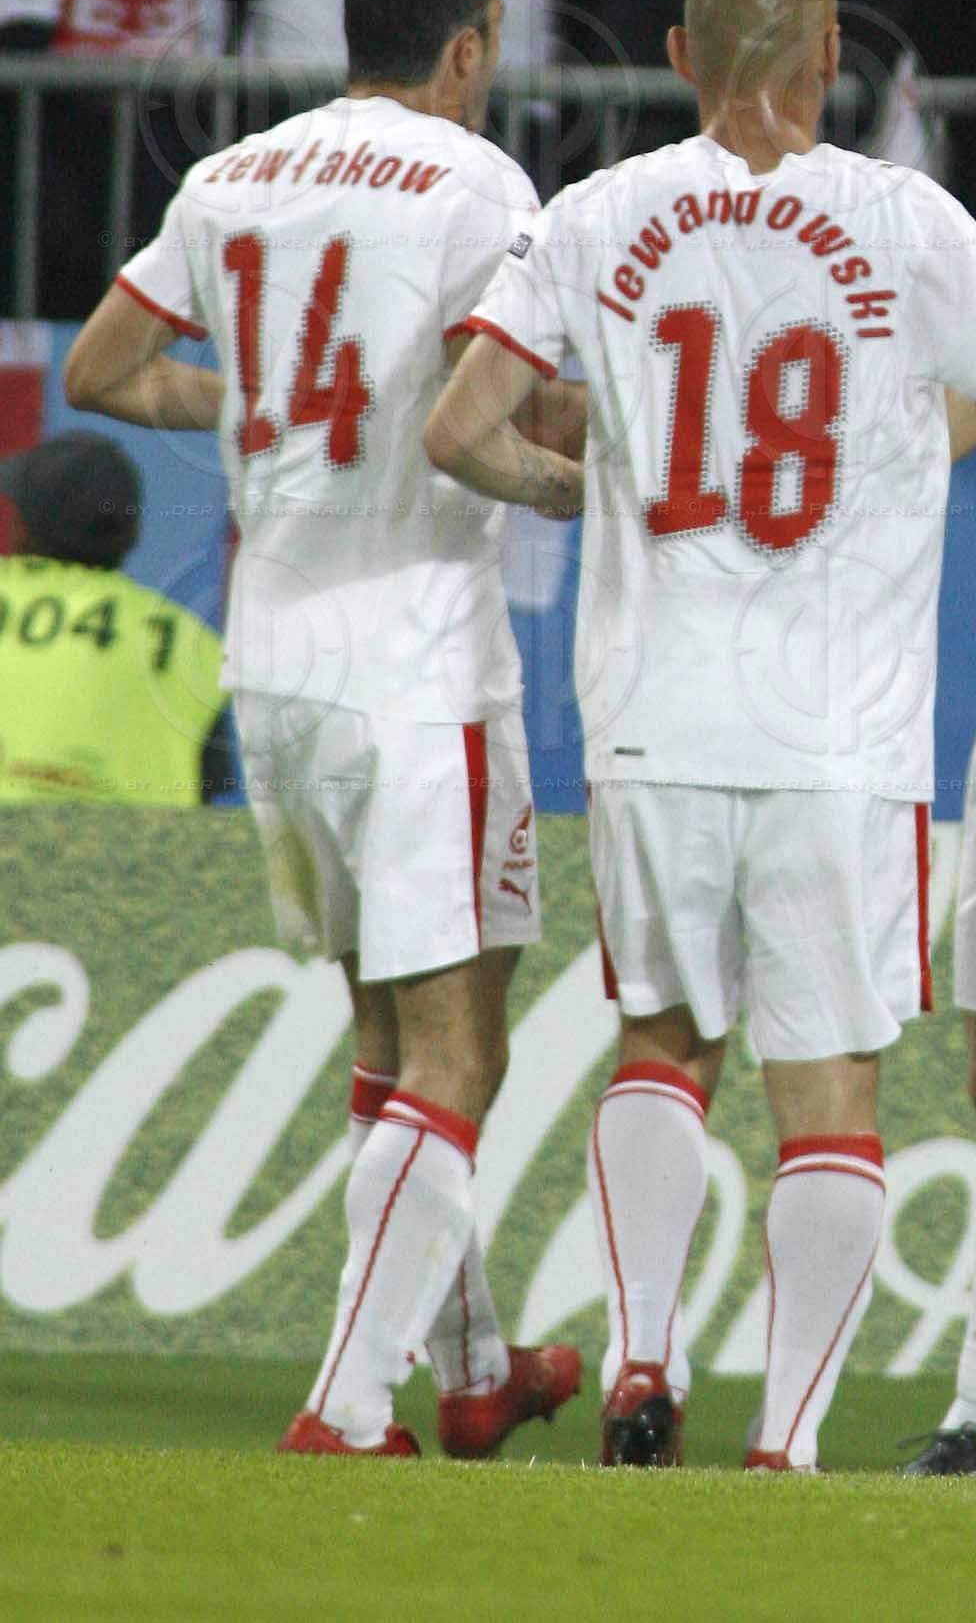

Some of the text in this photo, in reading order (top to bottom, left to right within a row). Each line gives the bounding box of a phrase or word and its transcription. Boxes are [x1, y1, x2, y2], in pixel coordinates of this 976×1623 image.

[223, 227, 375, 470] 14
[597, 188, 898, 340] lewandowski
[641, 300, 853, 555] 18
[0, 595, 178, 674] 041
